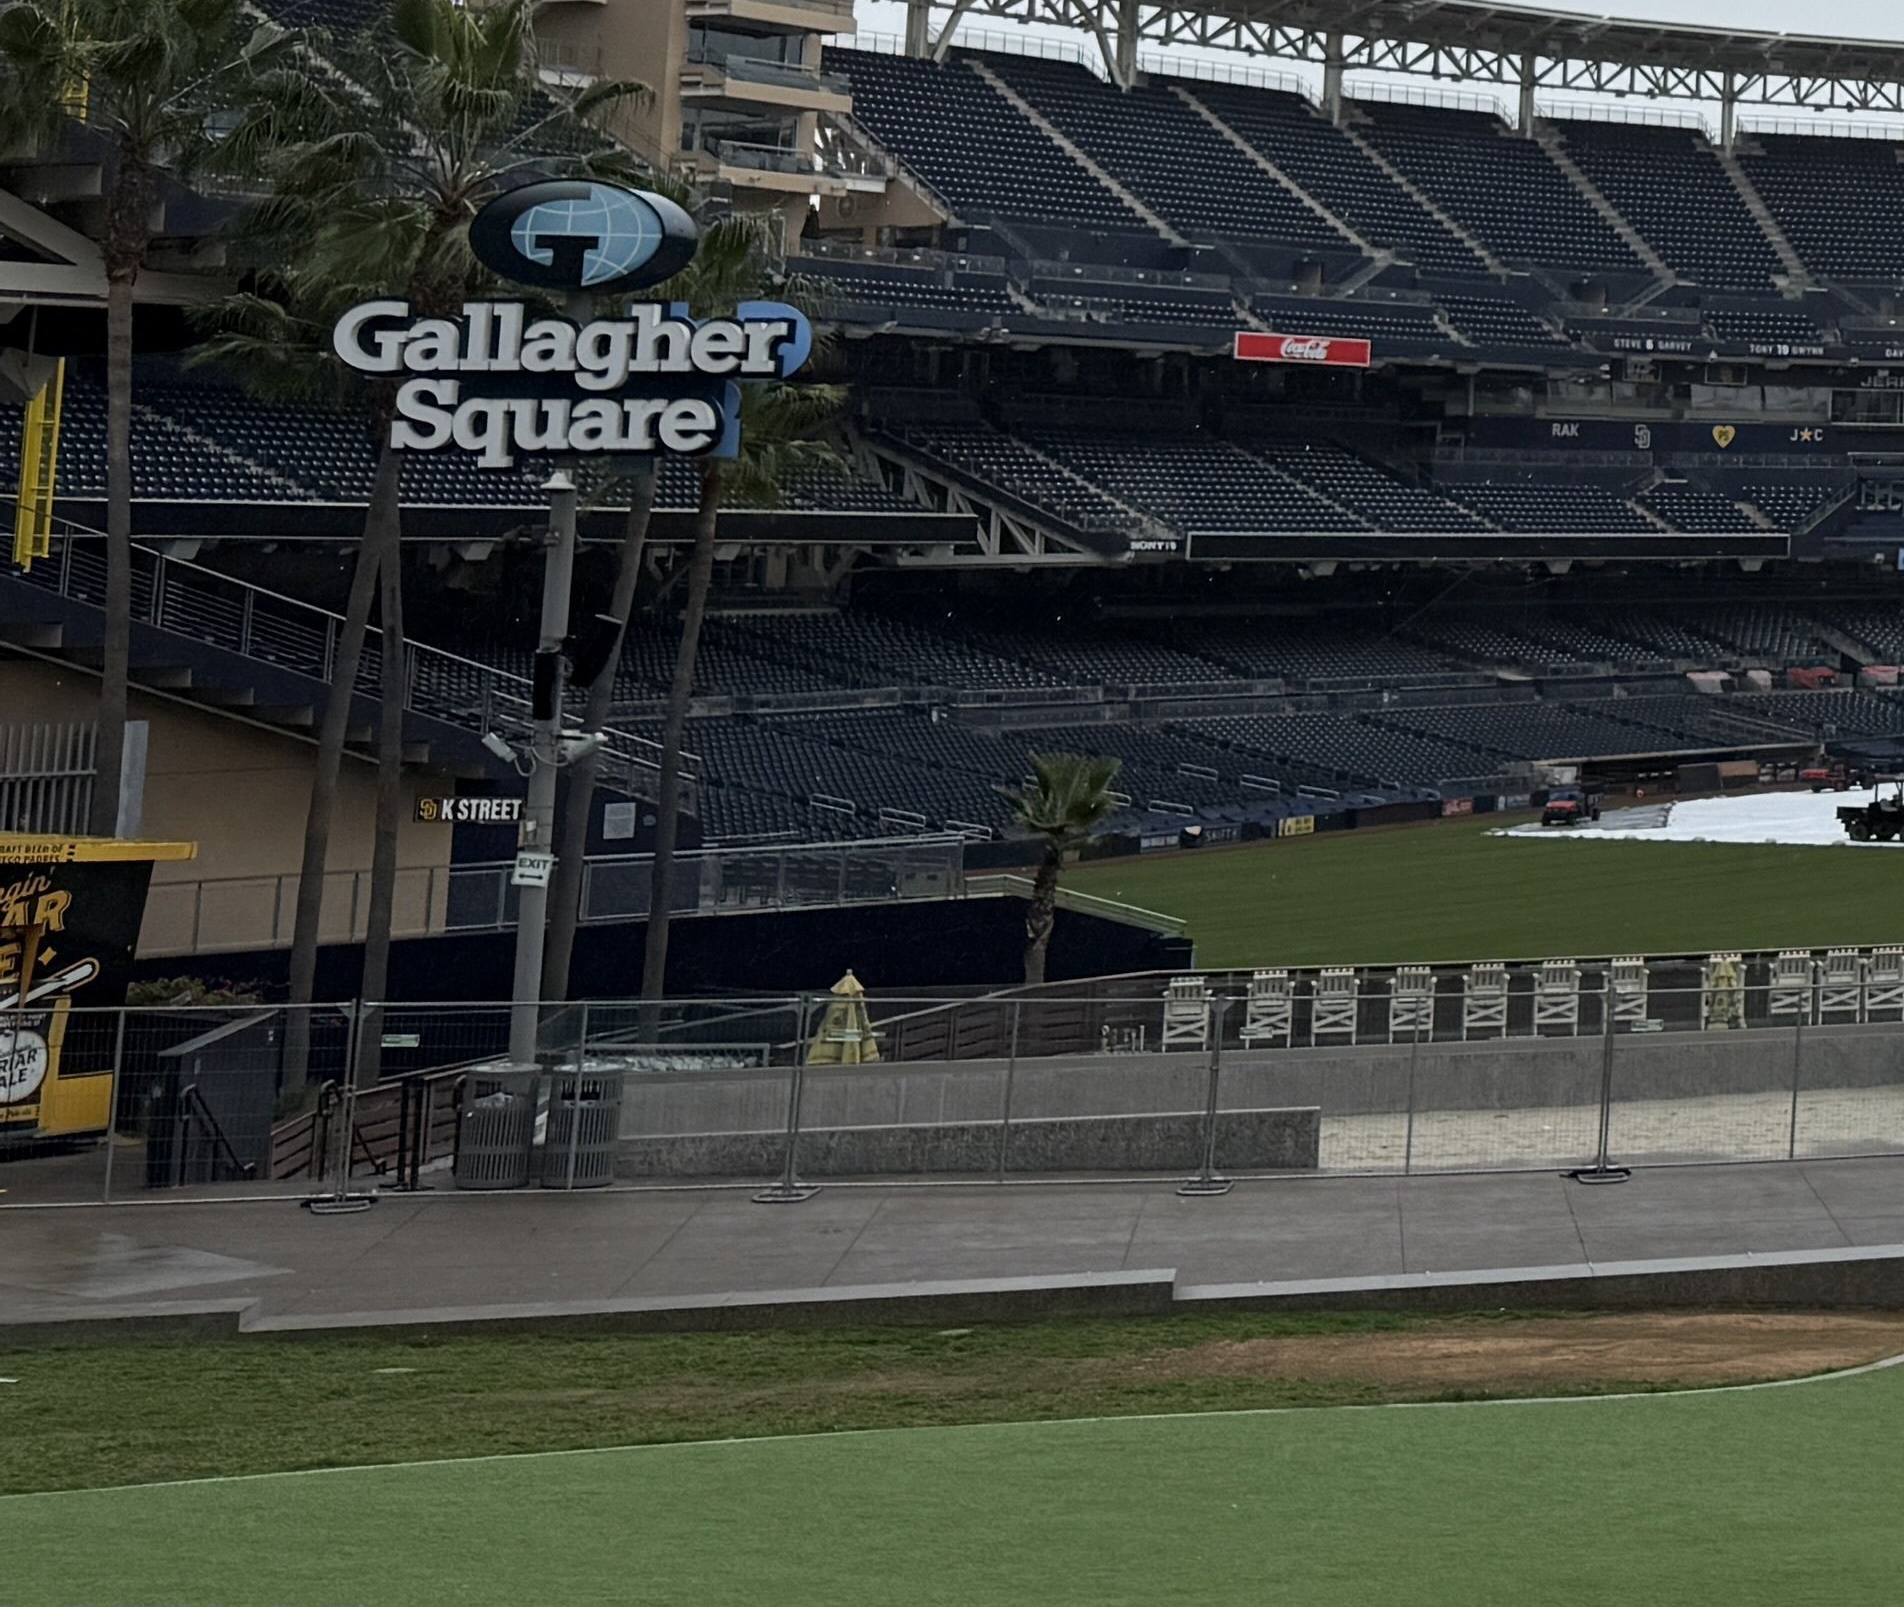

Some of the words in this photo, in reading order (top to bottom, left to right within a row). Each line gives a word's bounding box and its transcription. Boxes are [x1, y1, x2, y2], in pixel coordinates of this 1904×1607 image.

[333, 300, 789, 391] Gallagher
[1280, 338, 1331, 360] Coca-Cola
[390, 379, 717, 469] Square
[1552, 423, 1579, 437] RAK
[441, 799, 454, 820] K
[457, 799, 522, 821] STREET
[518, 858, 550, 870] EXIT
